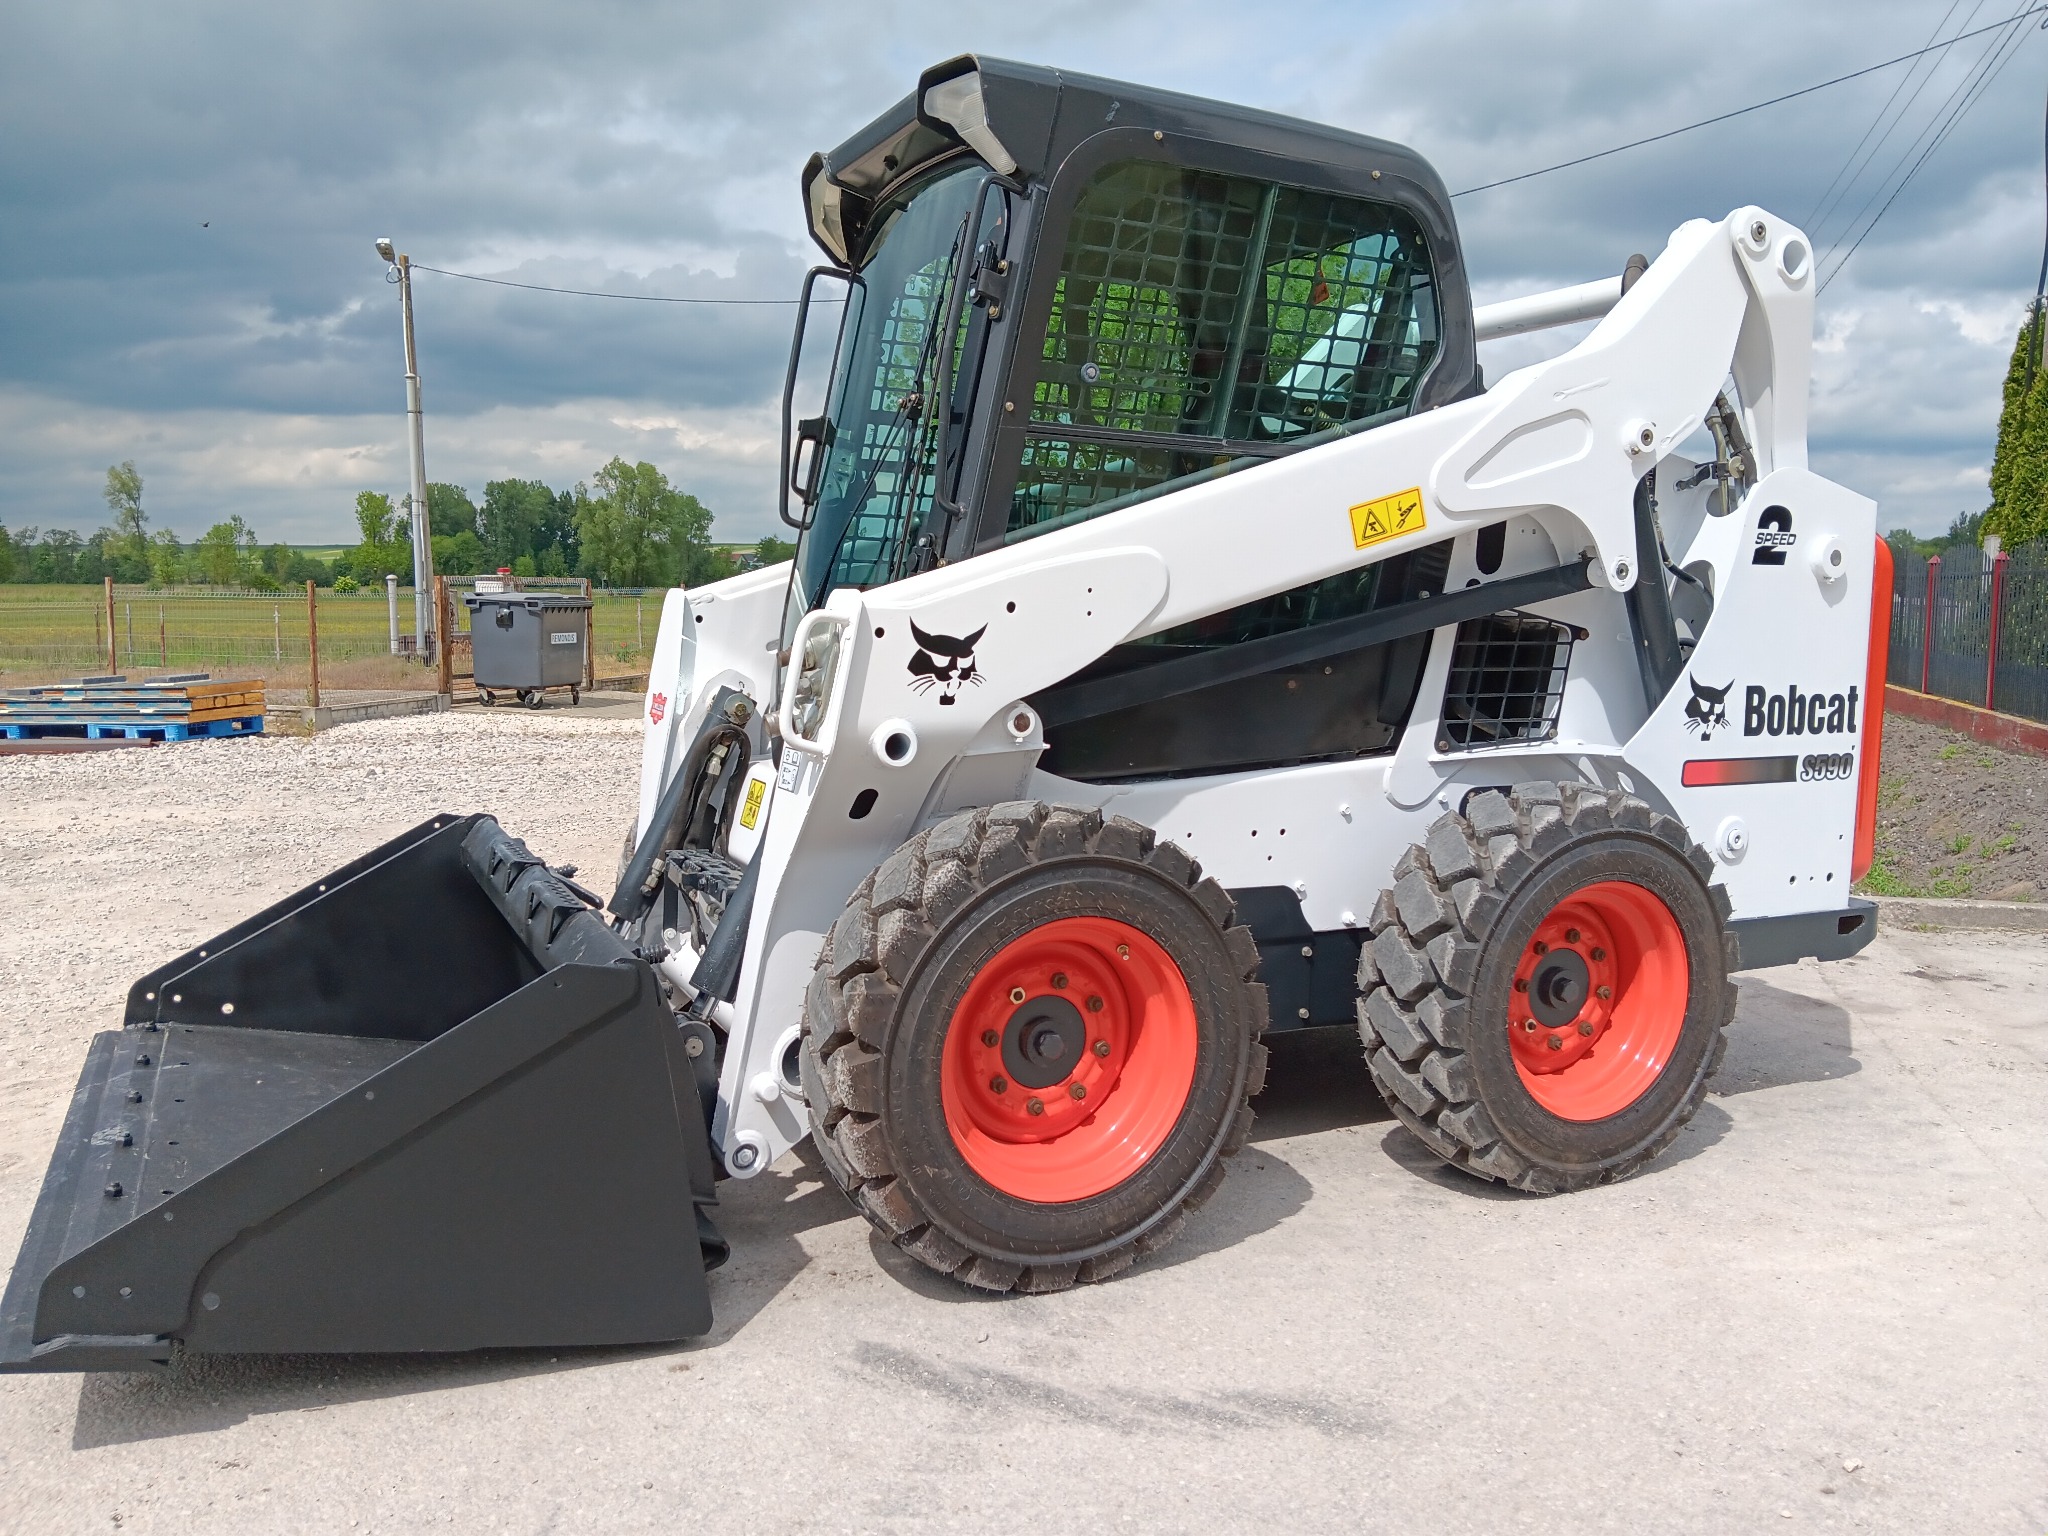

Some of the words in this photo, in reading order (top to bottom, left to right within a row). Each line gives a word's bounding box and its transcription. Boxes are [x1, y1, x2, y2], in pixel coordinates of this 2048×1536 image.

[1752, 505, 1792, 565] 2
[1755, 533, 1796, 545] SPEED
[1744, 685, 1858, 736] Bobcat
[1800, 753, 1854, 782] S590
